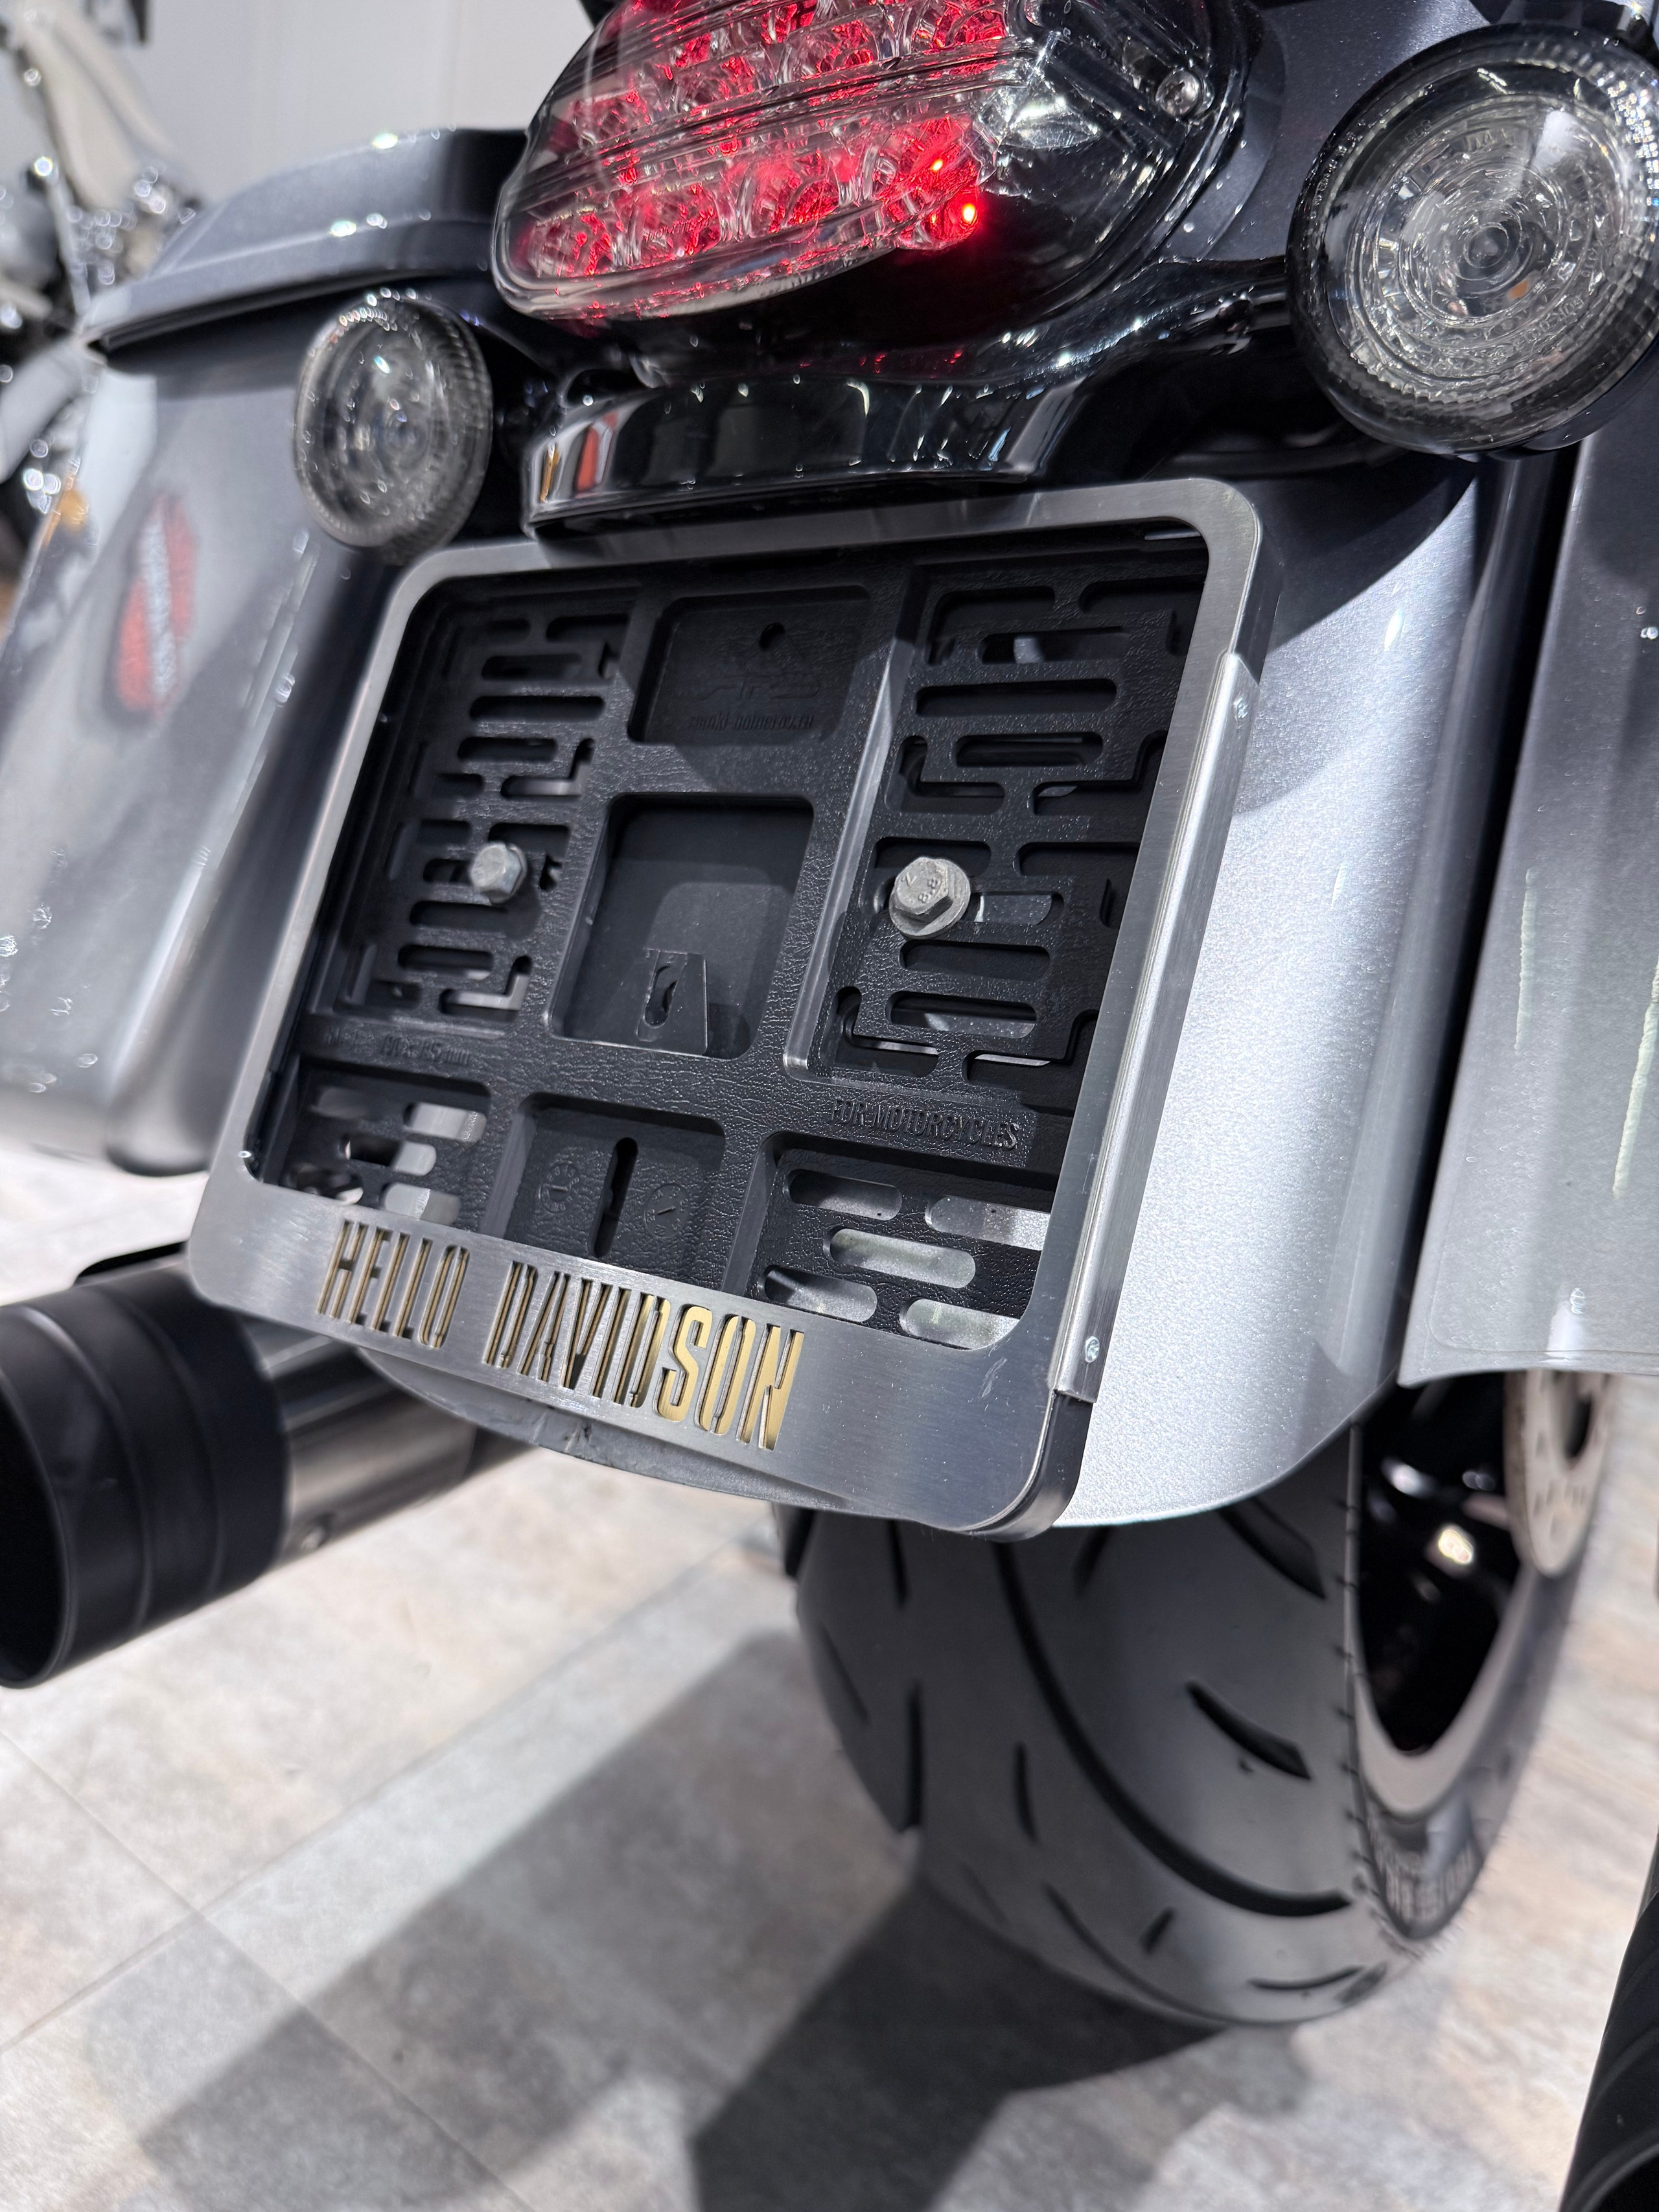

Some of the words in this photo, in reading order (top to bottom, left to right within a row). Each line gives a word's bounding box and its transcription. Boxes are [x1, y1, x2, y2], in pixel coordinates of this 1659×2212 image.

[830, 1100, 867, 1127] FOR
[872, 1106, 1019, 1150] MOTORCYCLES
[316, 1220, 470, 1349] HELLO
[482, 1260, 805, 1452] DAVIDSON
